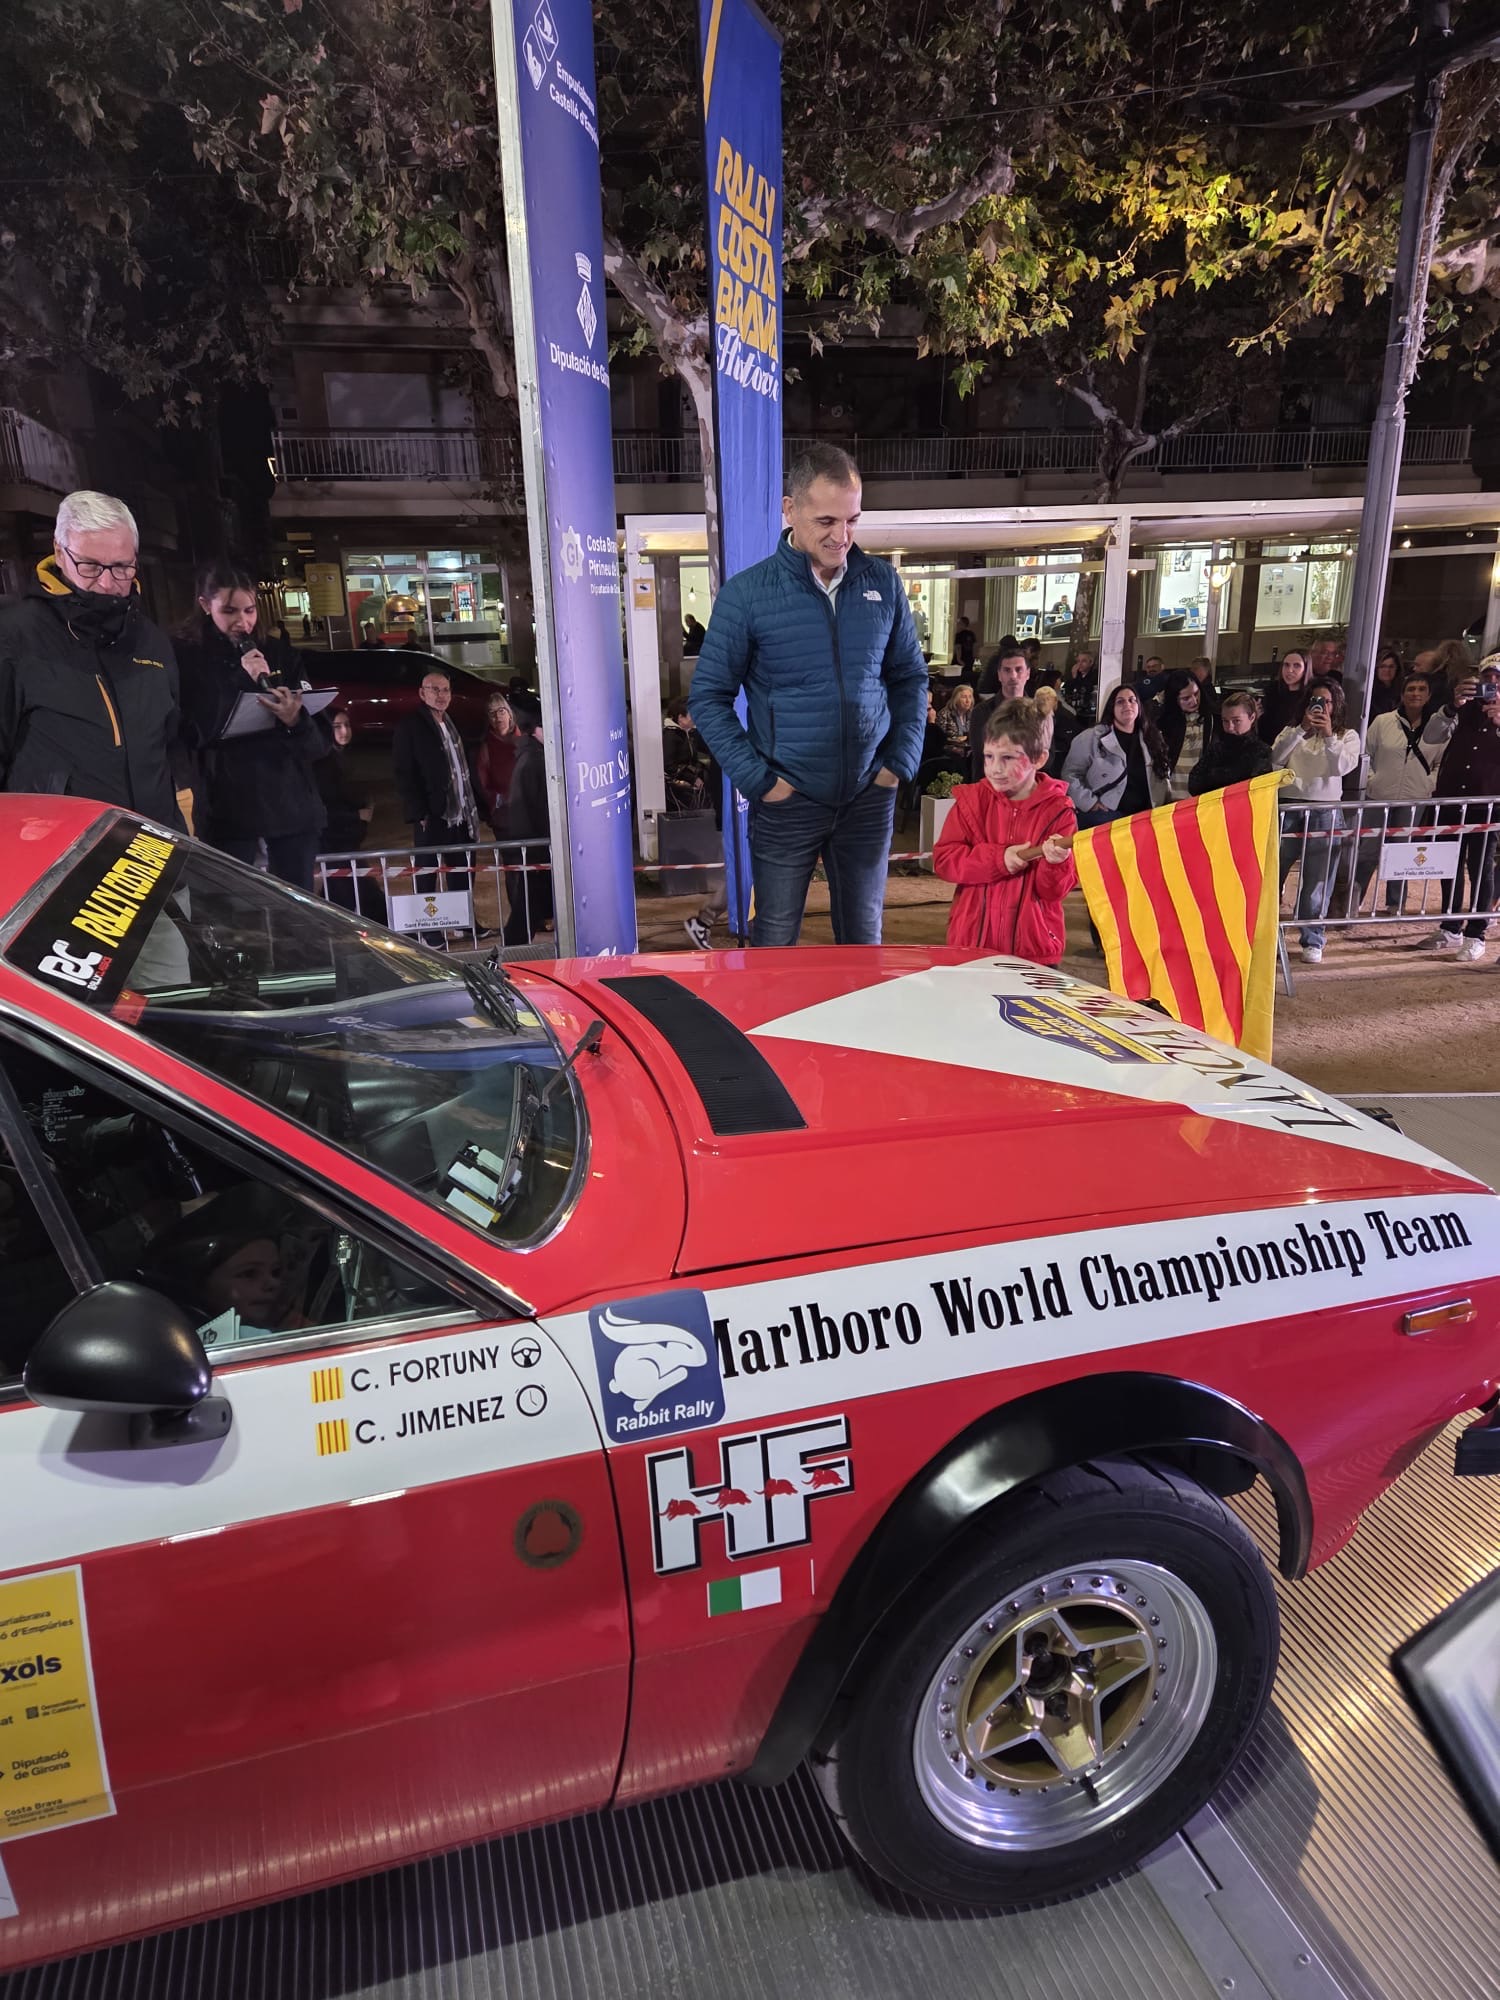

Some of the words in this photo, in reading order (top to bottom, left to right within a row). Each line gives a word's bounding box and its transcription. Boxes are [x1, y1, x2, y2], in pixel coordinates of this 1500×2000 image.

[549, 83, 579, 120] Castelló
[714, 136, 776, 238] RALLY
[718, 203, 776, 301] COSTA
[715, 268, 779, 363] BRAVA
[550, 342, 591, 377] Diputació
[591, 360, 600, 381] de
[716, 323, 779, 402] Històri
[586, 534, 607, 553] Costa
[125, 832, 175, 870] BRAVA
[102, 857, 162, 901] COSTA
[71, 884, 141, 948] RALLY
[1126, 1030, 1364, 1131] LANCIA
[930, 1261, 1073, 1337] World
[1079, 1219, 1367, 1311] Championship
[1364, 1209, 1472, 1260] Team
[351, 1368, 380, 1392] C.
[389, 1345, 500, 1387] FORTUNY
[355, 1419, 386, 1445] C.
[396, 1395, 506, 1438] JIMENEZ
[616, 1408, 671, 1433] Rabbit
[673, 1399, 716, 1425] Rally
[645, 1413, 855, 1578] HF
[0, 1654, 62, 1684] xols
[12, 1749, 70, 1770] Diputació
[14, 1771, 30, 1781] de
[31, 1761, 71, 1776] Girona
[4, 1806, 33, 1817] Costa
[35, 1799, 63, 1810] Brava
